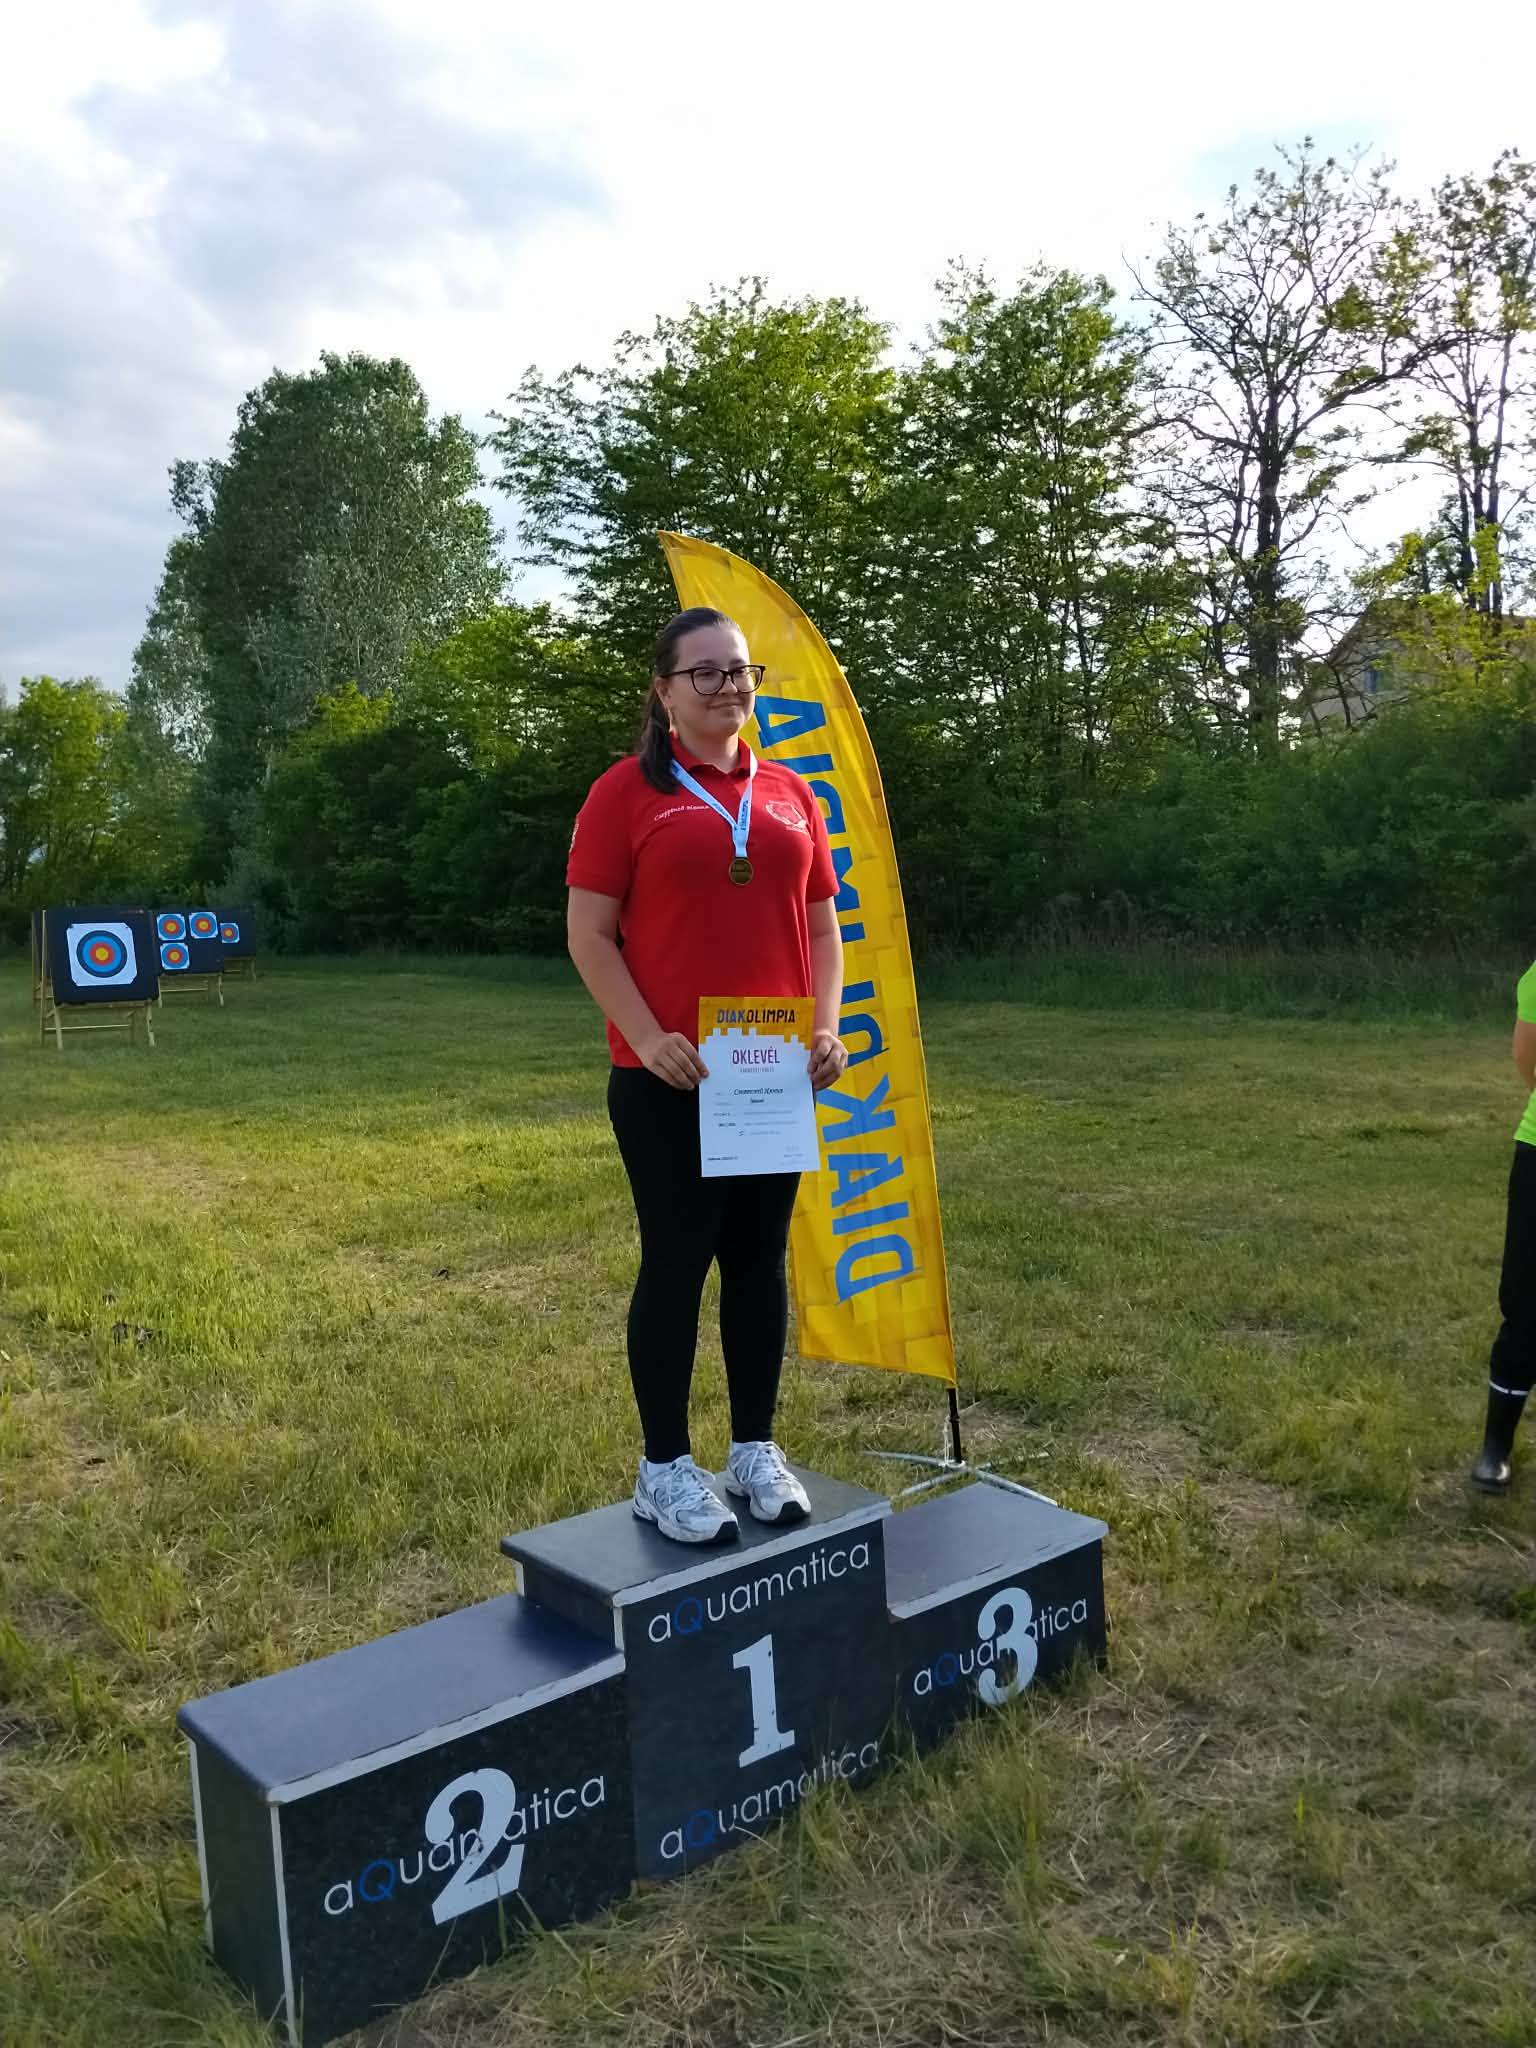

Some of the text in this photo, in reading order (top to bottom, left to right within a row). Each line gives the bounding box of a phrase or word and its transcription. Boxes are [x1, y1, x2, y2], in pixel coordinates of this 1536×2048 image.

[732, 1046, 781, 1065] OKLEVÉL
[648, 1542, 869, 1643] aQuamatica
[914, 1599, 1087, 1695] aQuaatica
[977, 1587, 1038, 1706] 3
[732, 1633, 796, 1768] 1
[425, 1768, 525, 1926] 2
